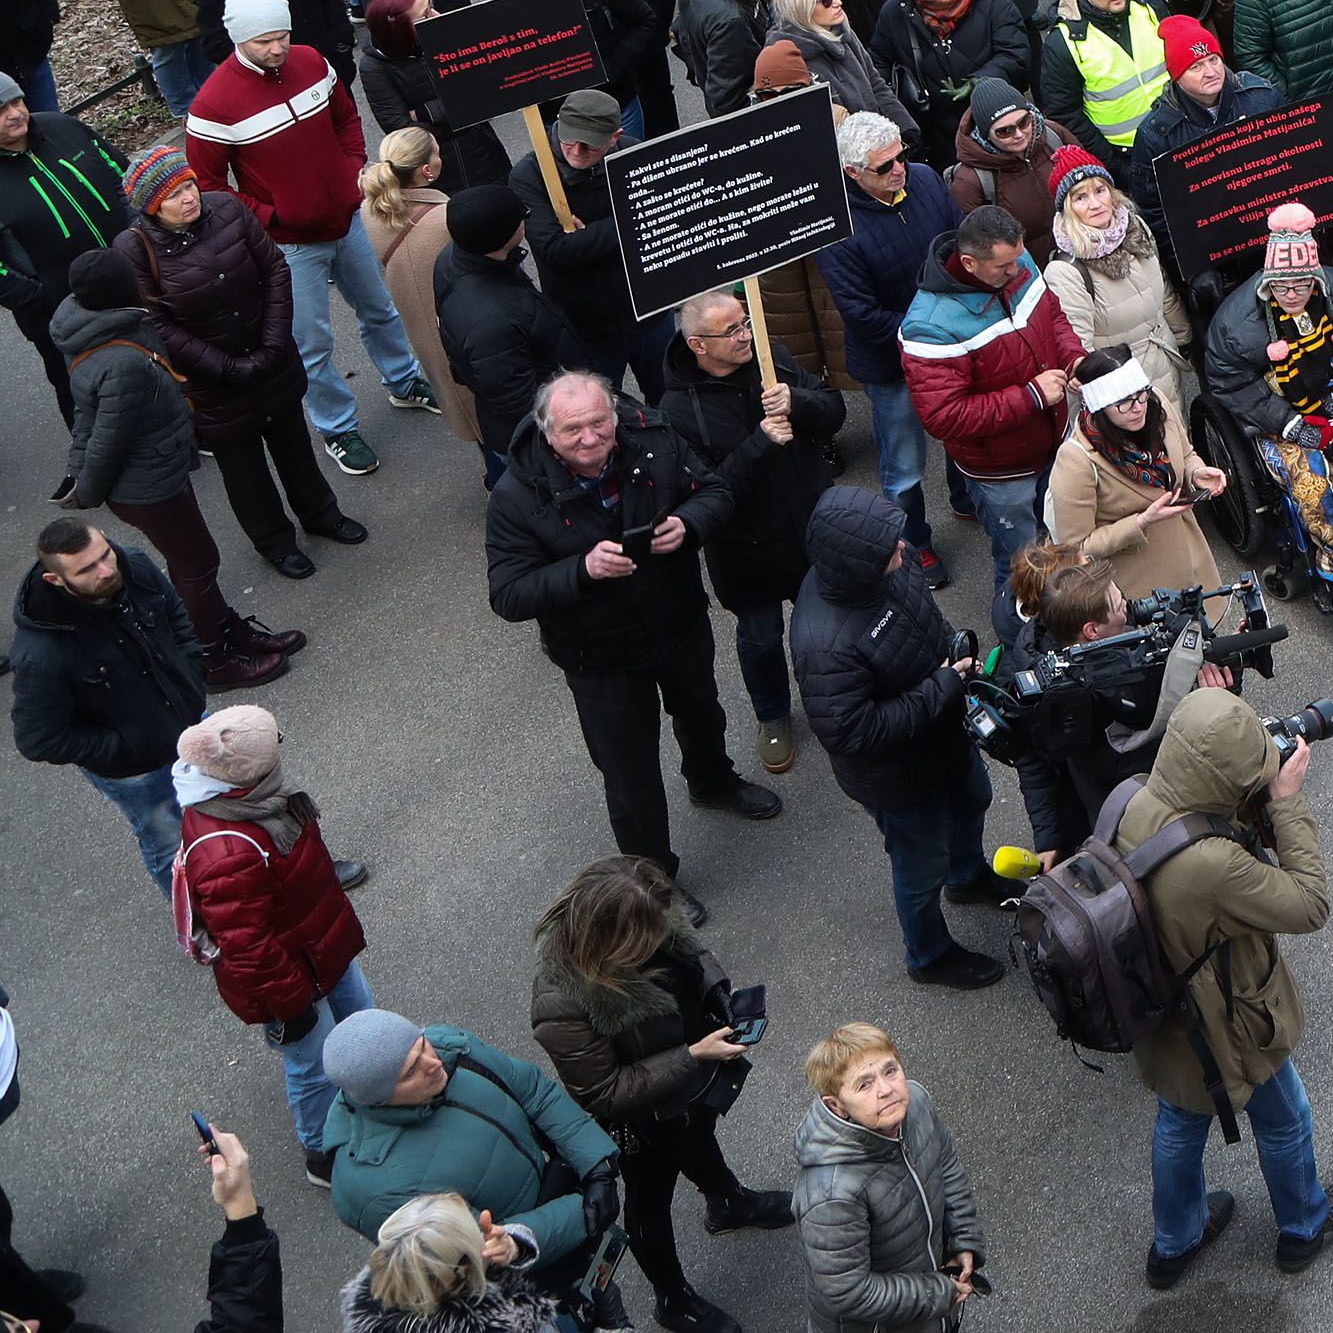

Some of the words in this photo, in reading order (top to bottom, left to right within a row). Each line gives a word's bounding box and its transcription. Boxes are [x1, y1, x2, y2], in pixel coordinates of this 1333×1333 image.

[440, 69, 449, 78] je
[488, 47, 522, 63] javljao
[524, 42, 536, 50] na
[458, 46, 478, 57] ima
[479, 36, 508, 50] Beroš
[517, 29, 538, 38] tim,
[1173, 146, 1199, 162] Protiv
[1201, 131, 1236, 148] sistema
[1237, 122, 1255, 134] koji
[1256, 120, 1265, 129] je
[1266, 114, 1287, 124] ubio
[1289, 103, 1322, 117] našega
[1185, 152, 1215, 169] kolegu
[1216, 134, 1263, 154] Vladimira
[1264, 116, 1316, 138] Matijanića!
[629, 164, 652, 178] Kakvi
[653, 161, 664, 169] ste
[670, 144, 708, 163] disanjem?
[1189, 184, 1200, 192] Za
[1202, 167, 1243, 187] neovisnu
[1244, 155, 1278, 170] istragu
[1279, 139, 1323, 159] okolnosti
[1227, 173, 1263, 190] njegove
[1264, 162, 1292, 177] smrti.
[1197, 219, 1208, 227] Za
[1210, 205, 1246, 222] ostavku
[1248, 191, 1287, 208] ministra
[1288, 176, 1333, 194] zdravstva
[1239, 211, 1264, 223] Vilija
[644, 262, 663, 273] neku
[664, 251, 691, 267] posudu
[721, 230, 748, 246] proliti.
